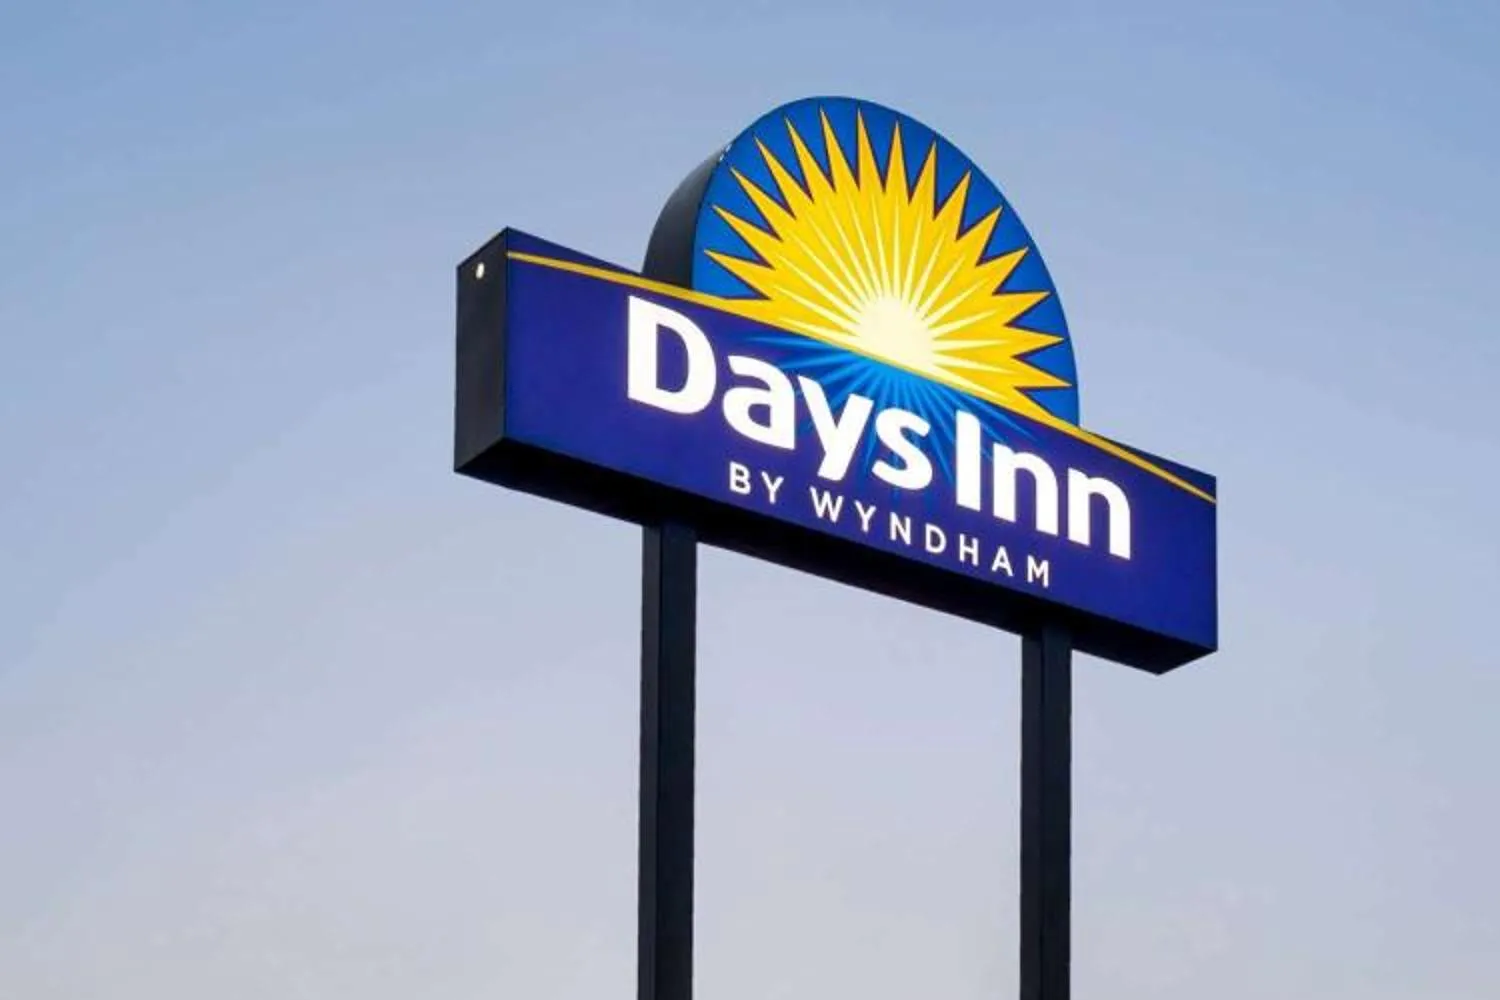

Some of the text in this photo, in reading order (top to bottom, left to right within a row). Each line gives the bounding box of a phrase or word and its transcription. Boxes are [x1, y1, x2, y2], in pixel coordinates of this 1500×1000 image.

[625, 295, 1134, 561] Days Inn
[728, 463, 1051, 587] BY WYNDHAM
